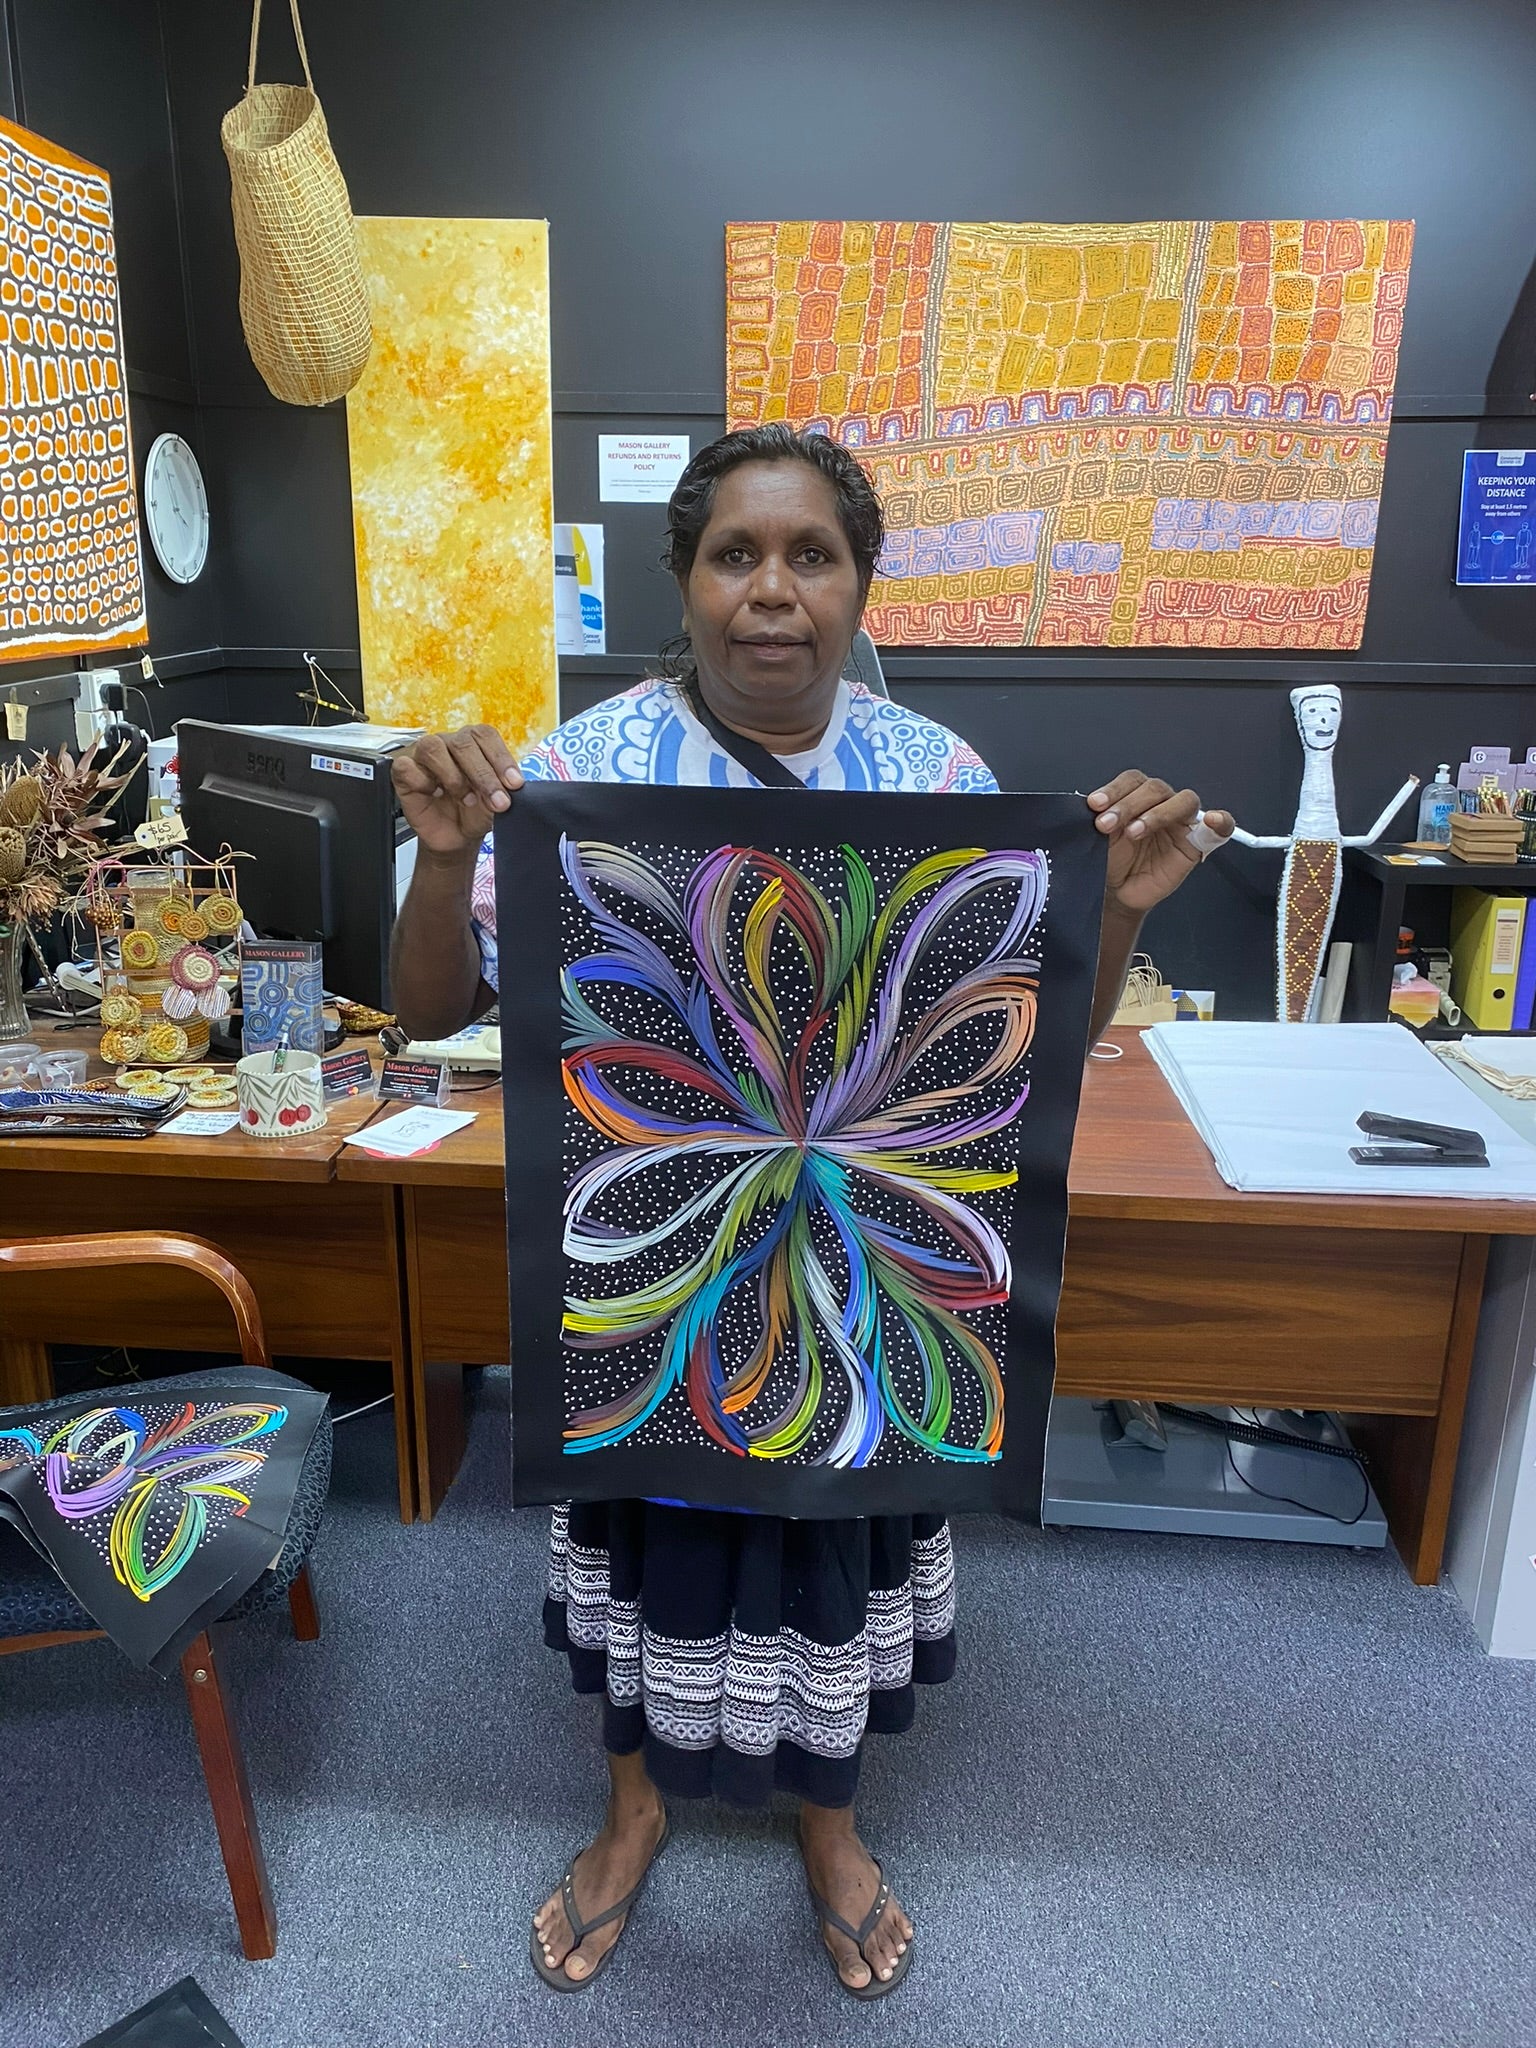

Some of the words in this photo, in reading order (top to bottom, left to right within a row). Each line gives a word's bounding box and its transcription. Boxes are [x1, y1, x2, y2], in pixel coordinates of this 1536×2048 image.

[1478, 476, 1512, 486] KEEPING
[1513, 476, 1536, 486] YOUR
[1486, 488, 1526, 498] DISTANCE
[581, 604, 600, 612] hank
[247, 751, 285, 782] BenQ
[148, 822, 171, 840] $65
[245, 949, 271, 957] MASON
[271, 950, 306, 958] GALLERY
[386, 1062, 411, 1072] Mason
[411, 1064, 438, 1076] Gallery
